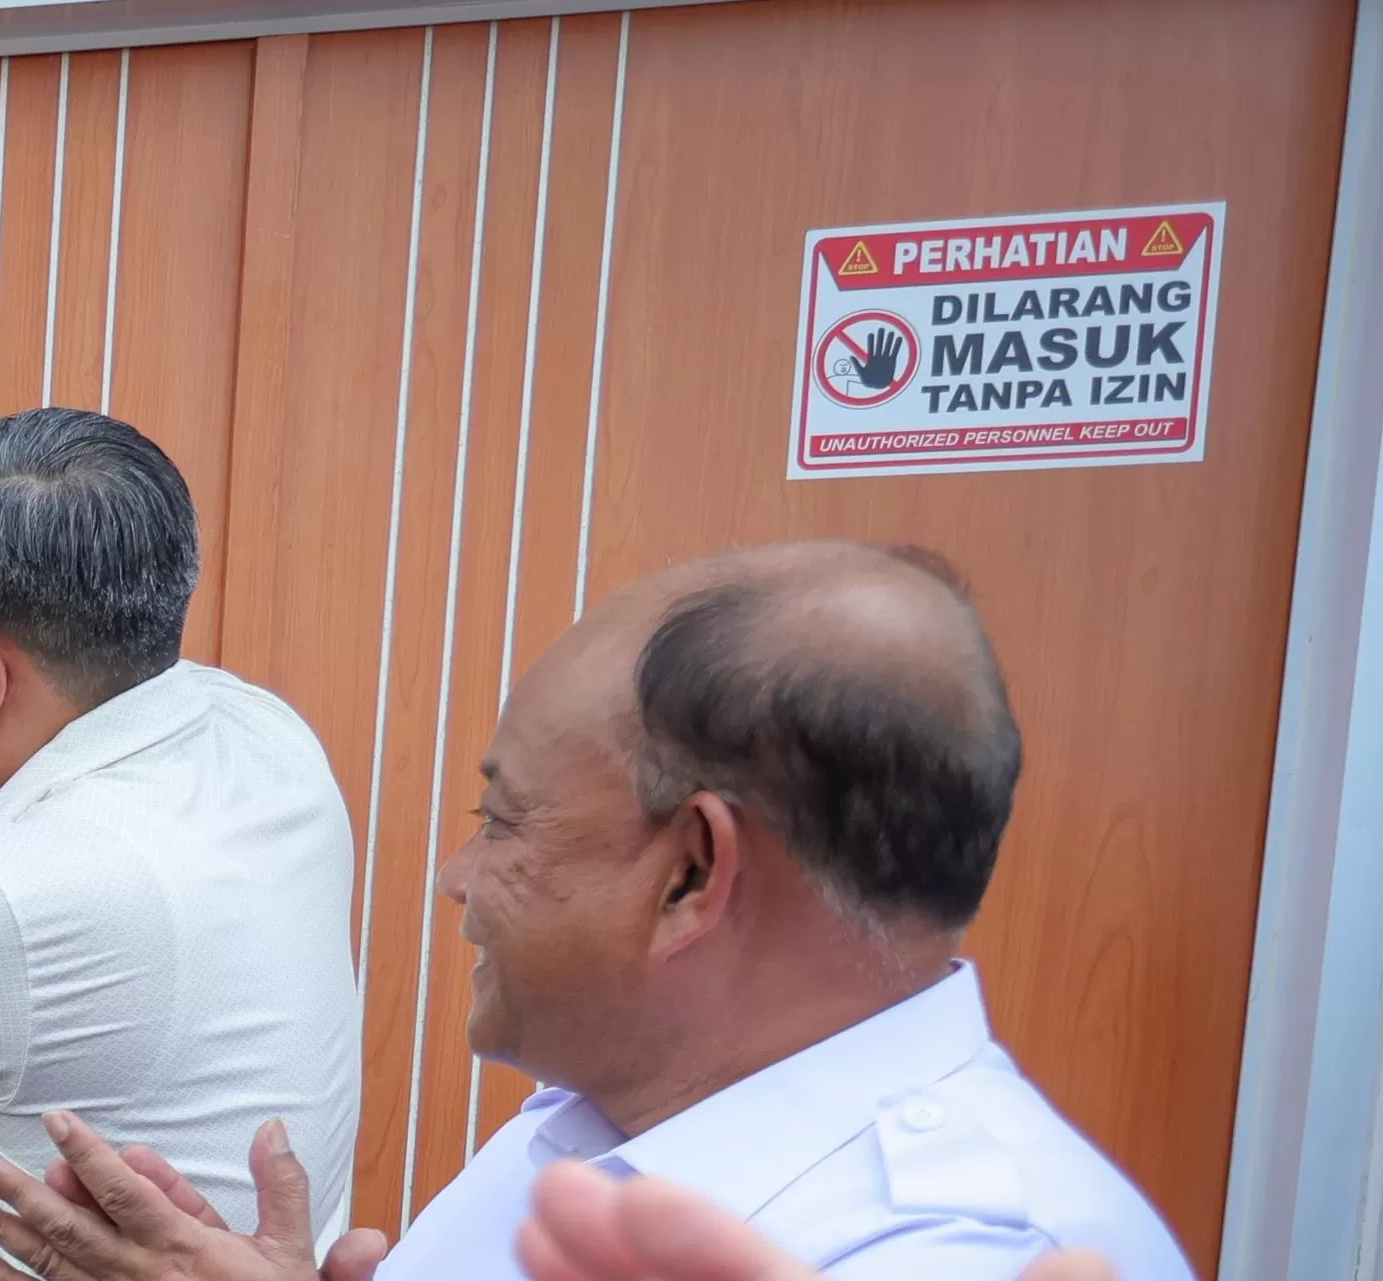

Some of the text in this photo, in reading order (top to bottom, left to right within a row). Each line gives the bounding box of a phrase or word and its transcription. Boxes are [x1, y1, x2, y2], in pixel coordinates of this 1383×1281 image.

[892, 227, 1129, 276] PERHATIAN
[931, 280, 1193, 326] DILARANG
[930, 321, 1188, 377] MASUK
[921, 372, 1187, 414] TANPA IZIN
[818, 421, 1174, 453] UNAUTHORIZED PERSONNEL KEEP OUT
